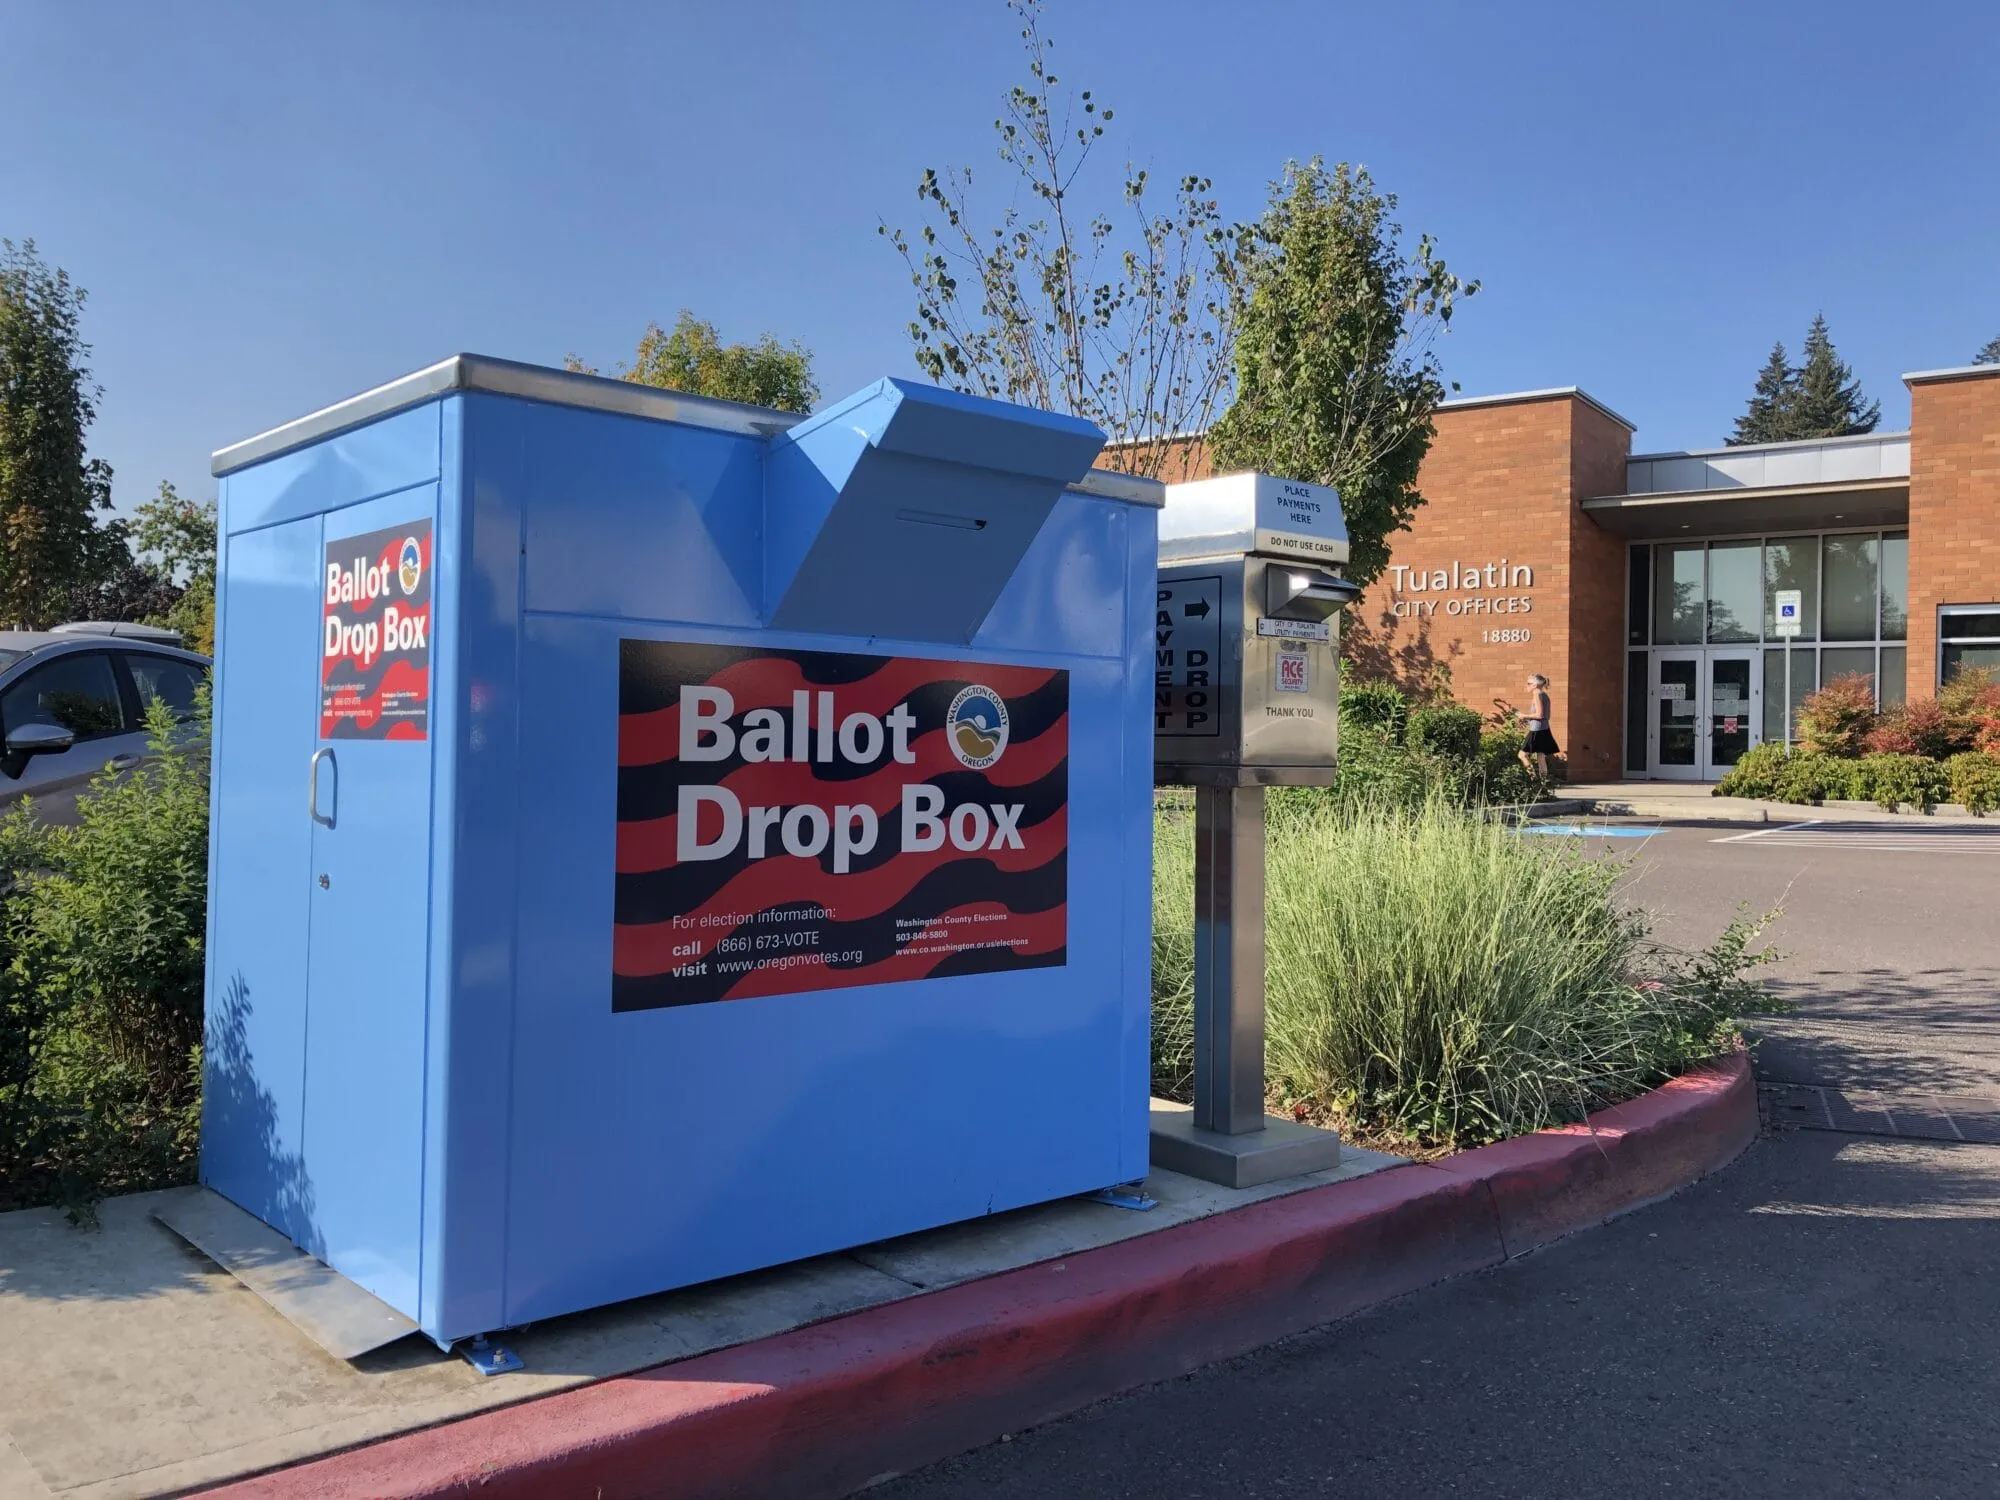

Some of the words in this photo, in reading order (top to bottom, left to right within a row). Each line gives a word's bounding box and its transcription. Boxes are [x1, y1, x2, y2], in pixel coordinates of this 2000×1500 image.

[1284, 485, 1310, 498] PLACE
[1277, 497, 1320, 513] PAYMENTS
[1290, 512, 1312, 525] HERE
[1270, 536, 1282, 546] DO
[1283, 540, 1298, 548] NOT
[1300, 541, 1313, 550] USE
[1315, 543, 1333, 553] CASH
[327, 556, 390, 605] Ballot
[1390, 558, 1534, 593] Tualatin
[1392, 600, 1439, 617] CITY
[1446, 596, 1532, 616] OFFICES
[324, 615, 378, 664] Drop
[383, 606, 426, 652] Box
[1482, 628, 1532, 643] 18880
[1281, 659, 1304, 679] ACE
[1185, 649, 1209, 729] DROP
[1280, 678, 1304, 686] SECURITY
[948, 687, 988, 724] WASHINGTON
[988, 691, 1008, 727] COUNTY
[1265, 706, 1295, 717] THANK
[1297, 708, 1314, 718] YOU
[679, 685, 916, 765] Ballot
[961, 754, 994, 767] OREGON
[676, 784, 879, 874] Drop
[901, 783, 1025, 853] Box
[672, 915, 696, 930] For
[700, 911, 754, 928] election
[758, 906, 836, 924] information:
[896, 917, 943, 928] Washington
[944, 915, 972, 925] County
[974, 912, 1008, 922] Elections
[672, 941, 701, 957] call
[716, 937, 751, 955] (866)
[756, 931, 819, 949] 673-VOTE
[895, 930, 948, 942] 503-846-5800
[895, 938, 1029, 956] www.co.washington.or.us/elections
[672, 962, 707, 978] visit
[716, 949, 863, 974] www.oregonvotes.org
